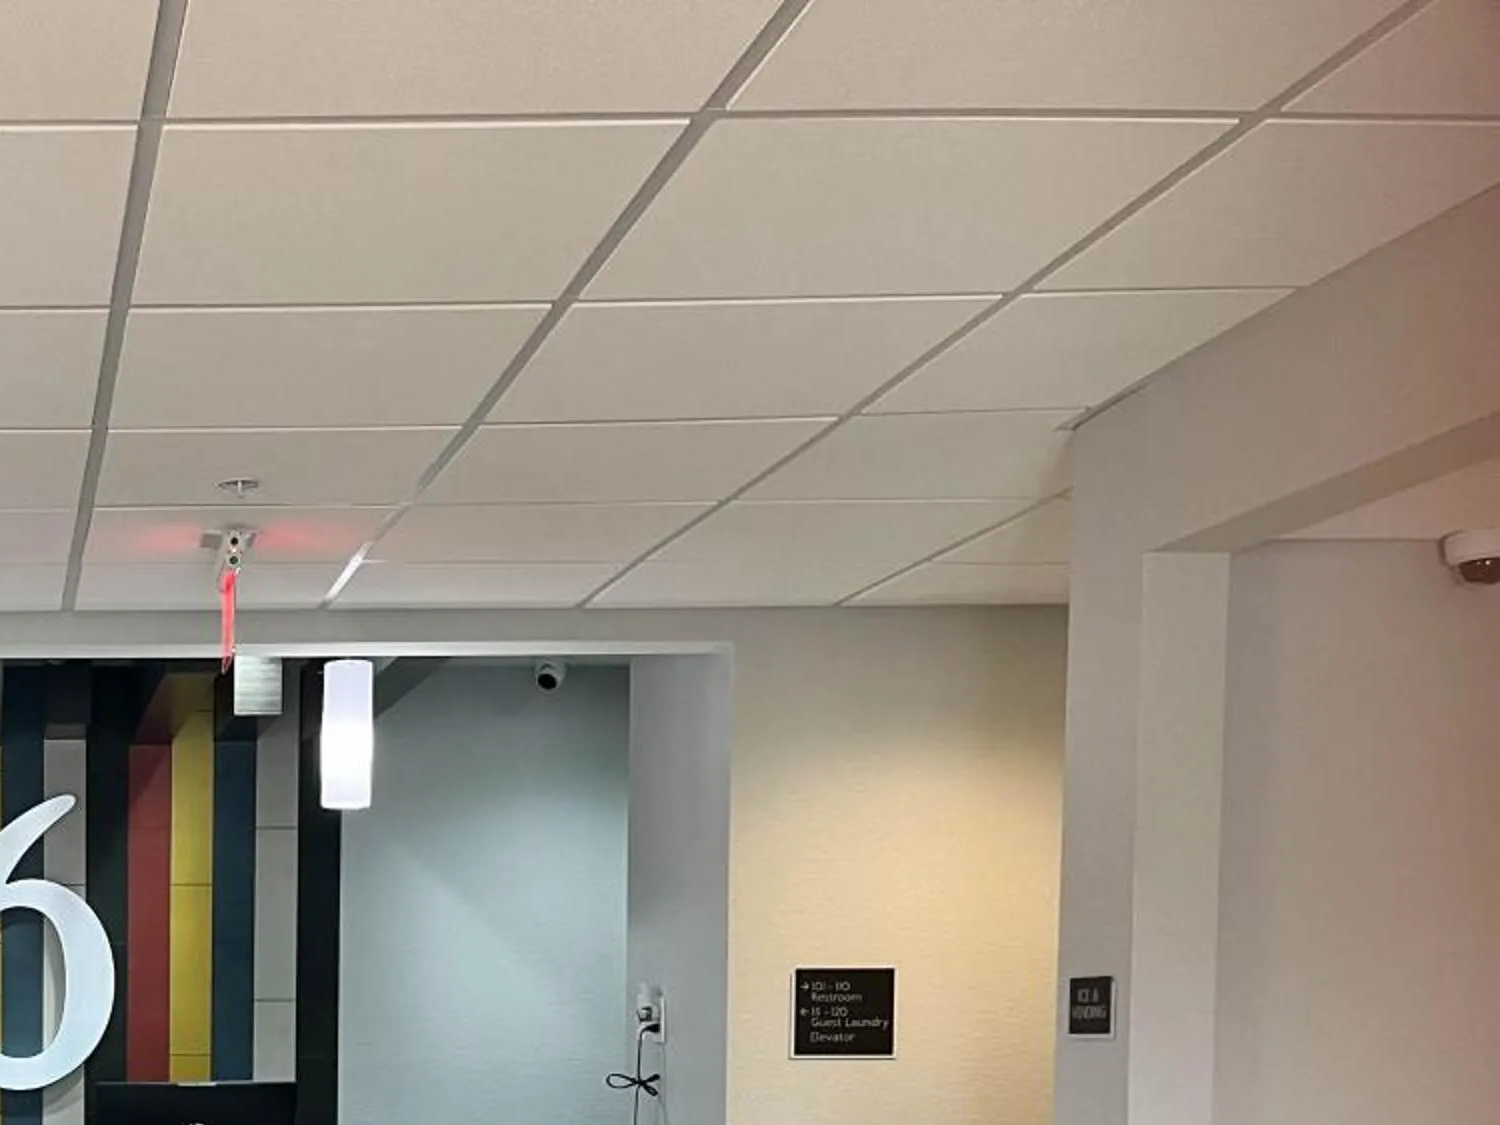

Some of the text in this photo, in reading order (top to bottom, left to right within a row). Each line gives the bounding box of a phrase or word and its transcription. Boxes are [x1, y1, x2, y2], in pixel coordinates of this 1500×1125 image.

[811, 992, 863, 1002] Restroom
[811, 1016, 889, 1030] Guest Laundry
